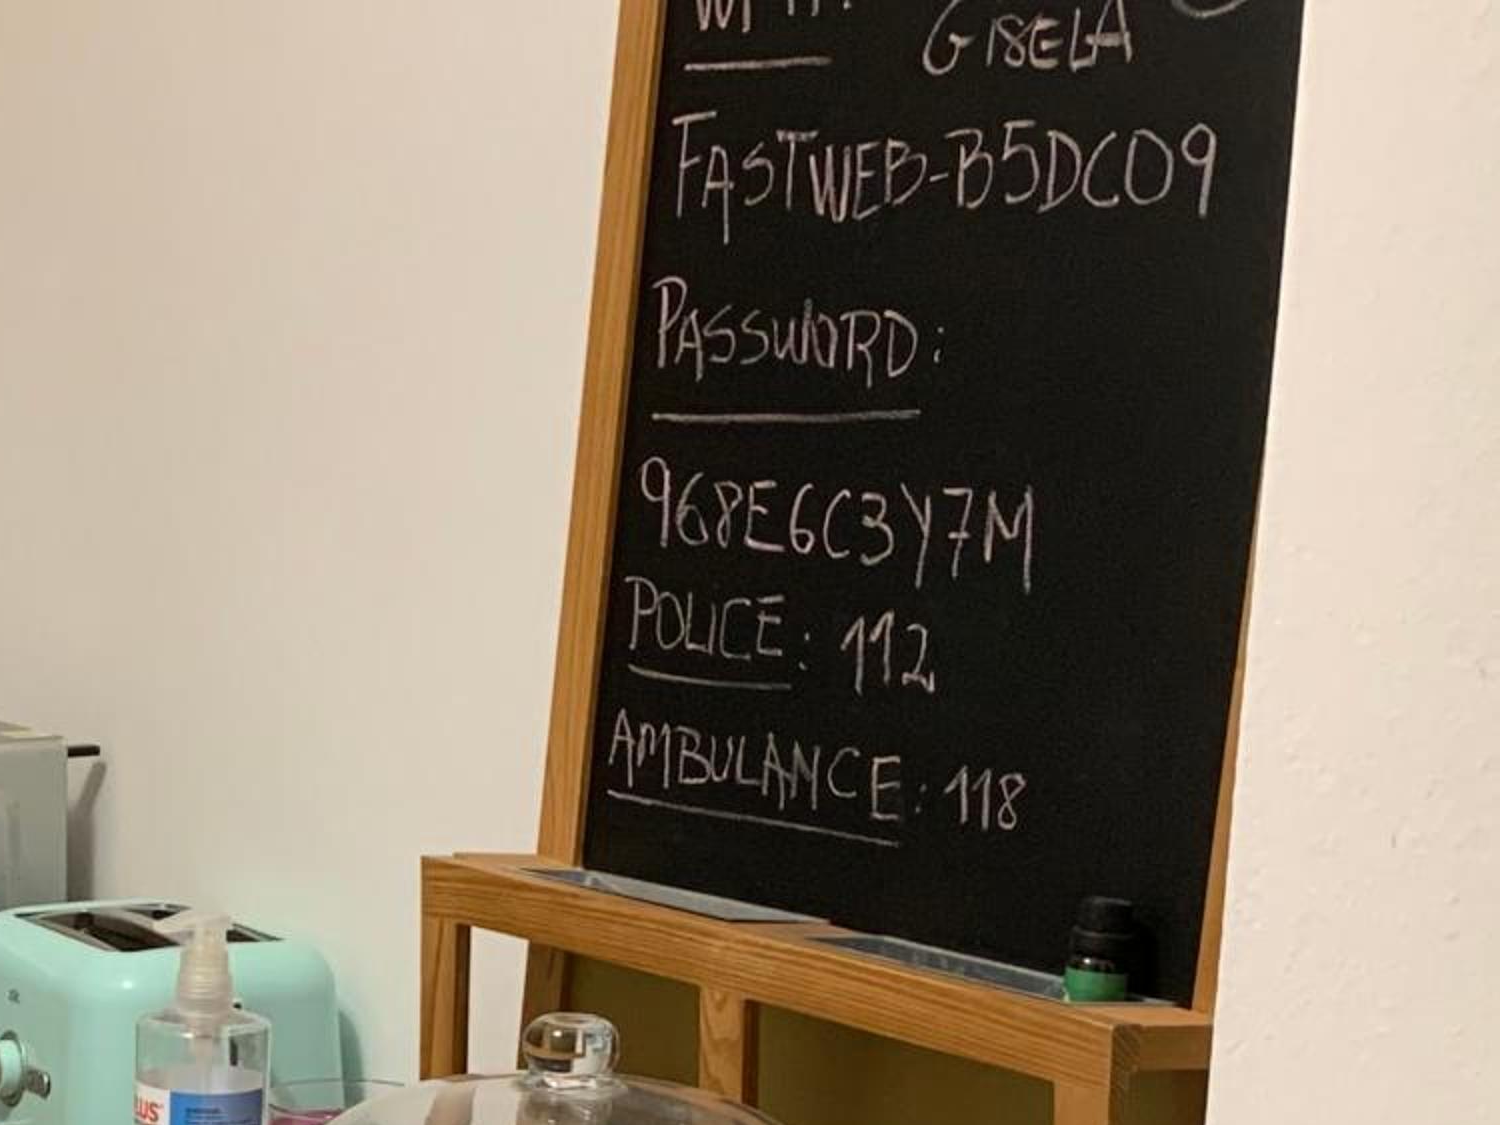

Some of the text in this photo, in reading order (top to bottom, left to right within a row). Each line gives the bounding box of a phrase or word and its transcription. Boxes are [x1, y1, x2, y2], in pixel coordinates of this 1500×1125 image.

[922, 0, 1134, 75] GISELA
[640, 456, 1034, 595] 968E6C3Y7M
[840, 610, 936, 695] 112
[942, 764, 1028, 831] 118
